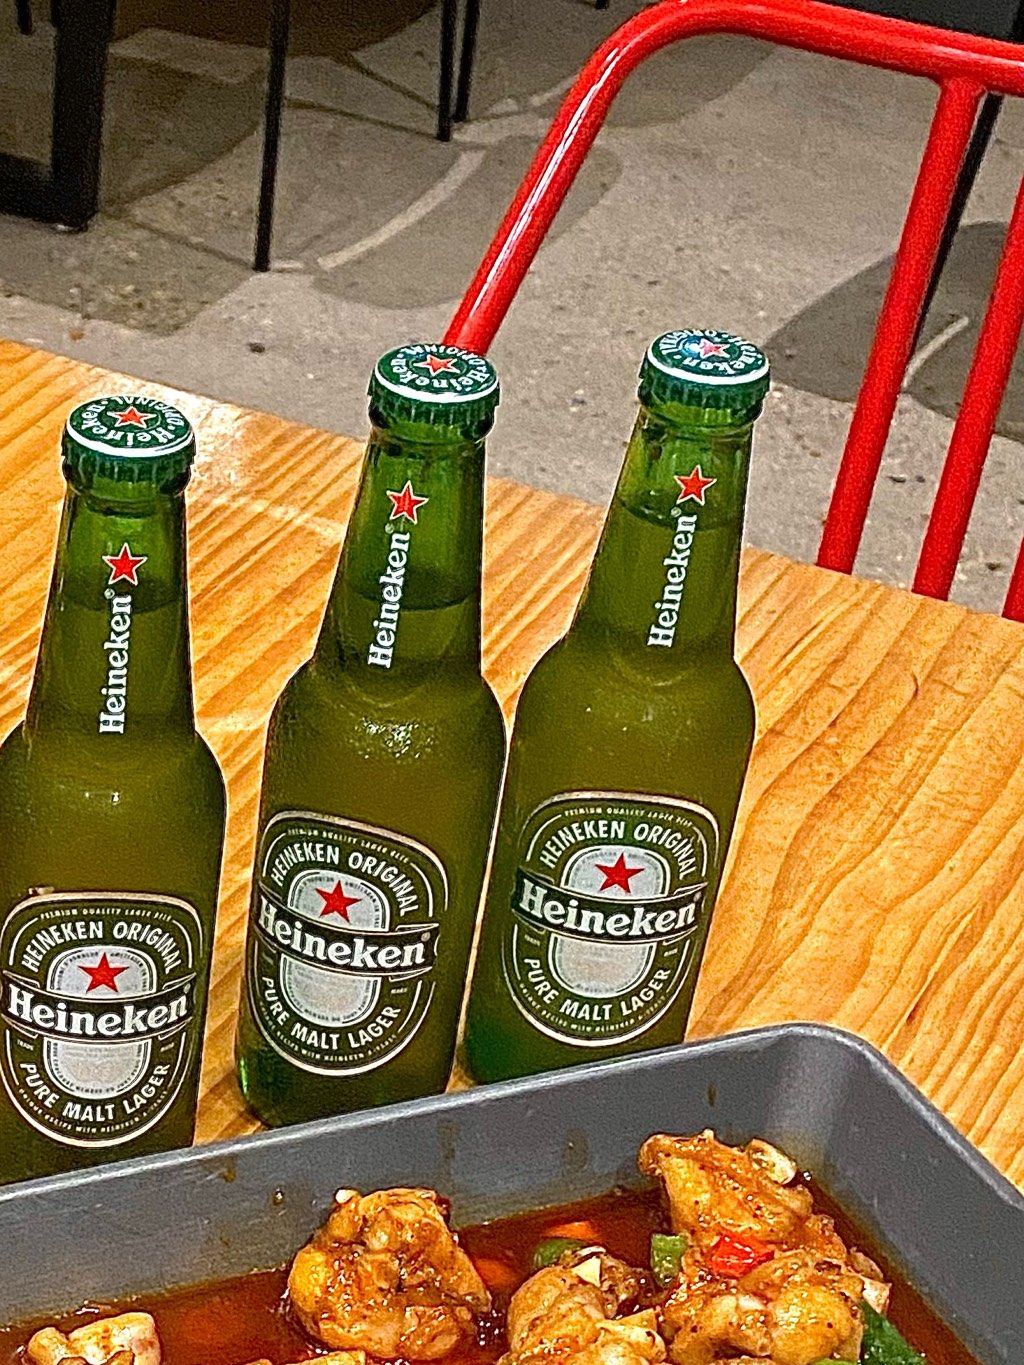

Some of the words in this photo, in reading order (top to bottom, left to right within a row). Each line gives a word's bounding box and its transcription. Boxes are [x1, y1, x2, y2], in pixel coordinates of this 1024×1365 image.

[391, 359, 491, 392] Heineken
[81, 404, 176, 447] Heineken
[368, 531, 410, 669] Heineken
[647, 514, 698, 648] Heineken
[99, 593, 132, 735] Heineken
[270, 842, 340, 887] HEINEKEN
[348, 852, 419, 917] ORIGINAL
[540, 820, 625, 869] HEINEKEN
[634, 823, 698, 880] ORIGINAL
[257, 895, 426, 969] Heineken
[519, 878, 696, 936] Heineken
[22, 921, 103, 973] HEINEKEN
[113, 921, 182, 974] ORIGINAL
[7, 983, 188, 1036] Heineken
[262, 976, 290, 1026] PURE
[291, 1022, 340, 1049] MALT
[348, 1006, 401, 1048] LAGER
[524, 958, 558, 1005] PURE
[560, 998, 613, 1021] MALT
[621, 968, 671, 1016] LAGER
[20, 1063, 59, 1109] PURE
[62, 1103, 115, 1122] MALT
[123, 1064, 171, 1114] LAGER
